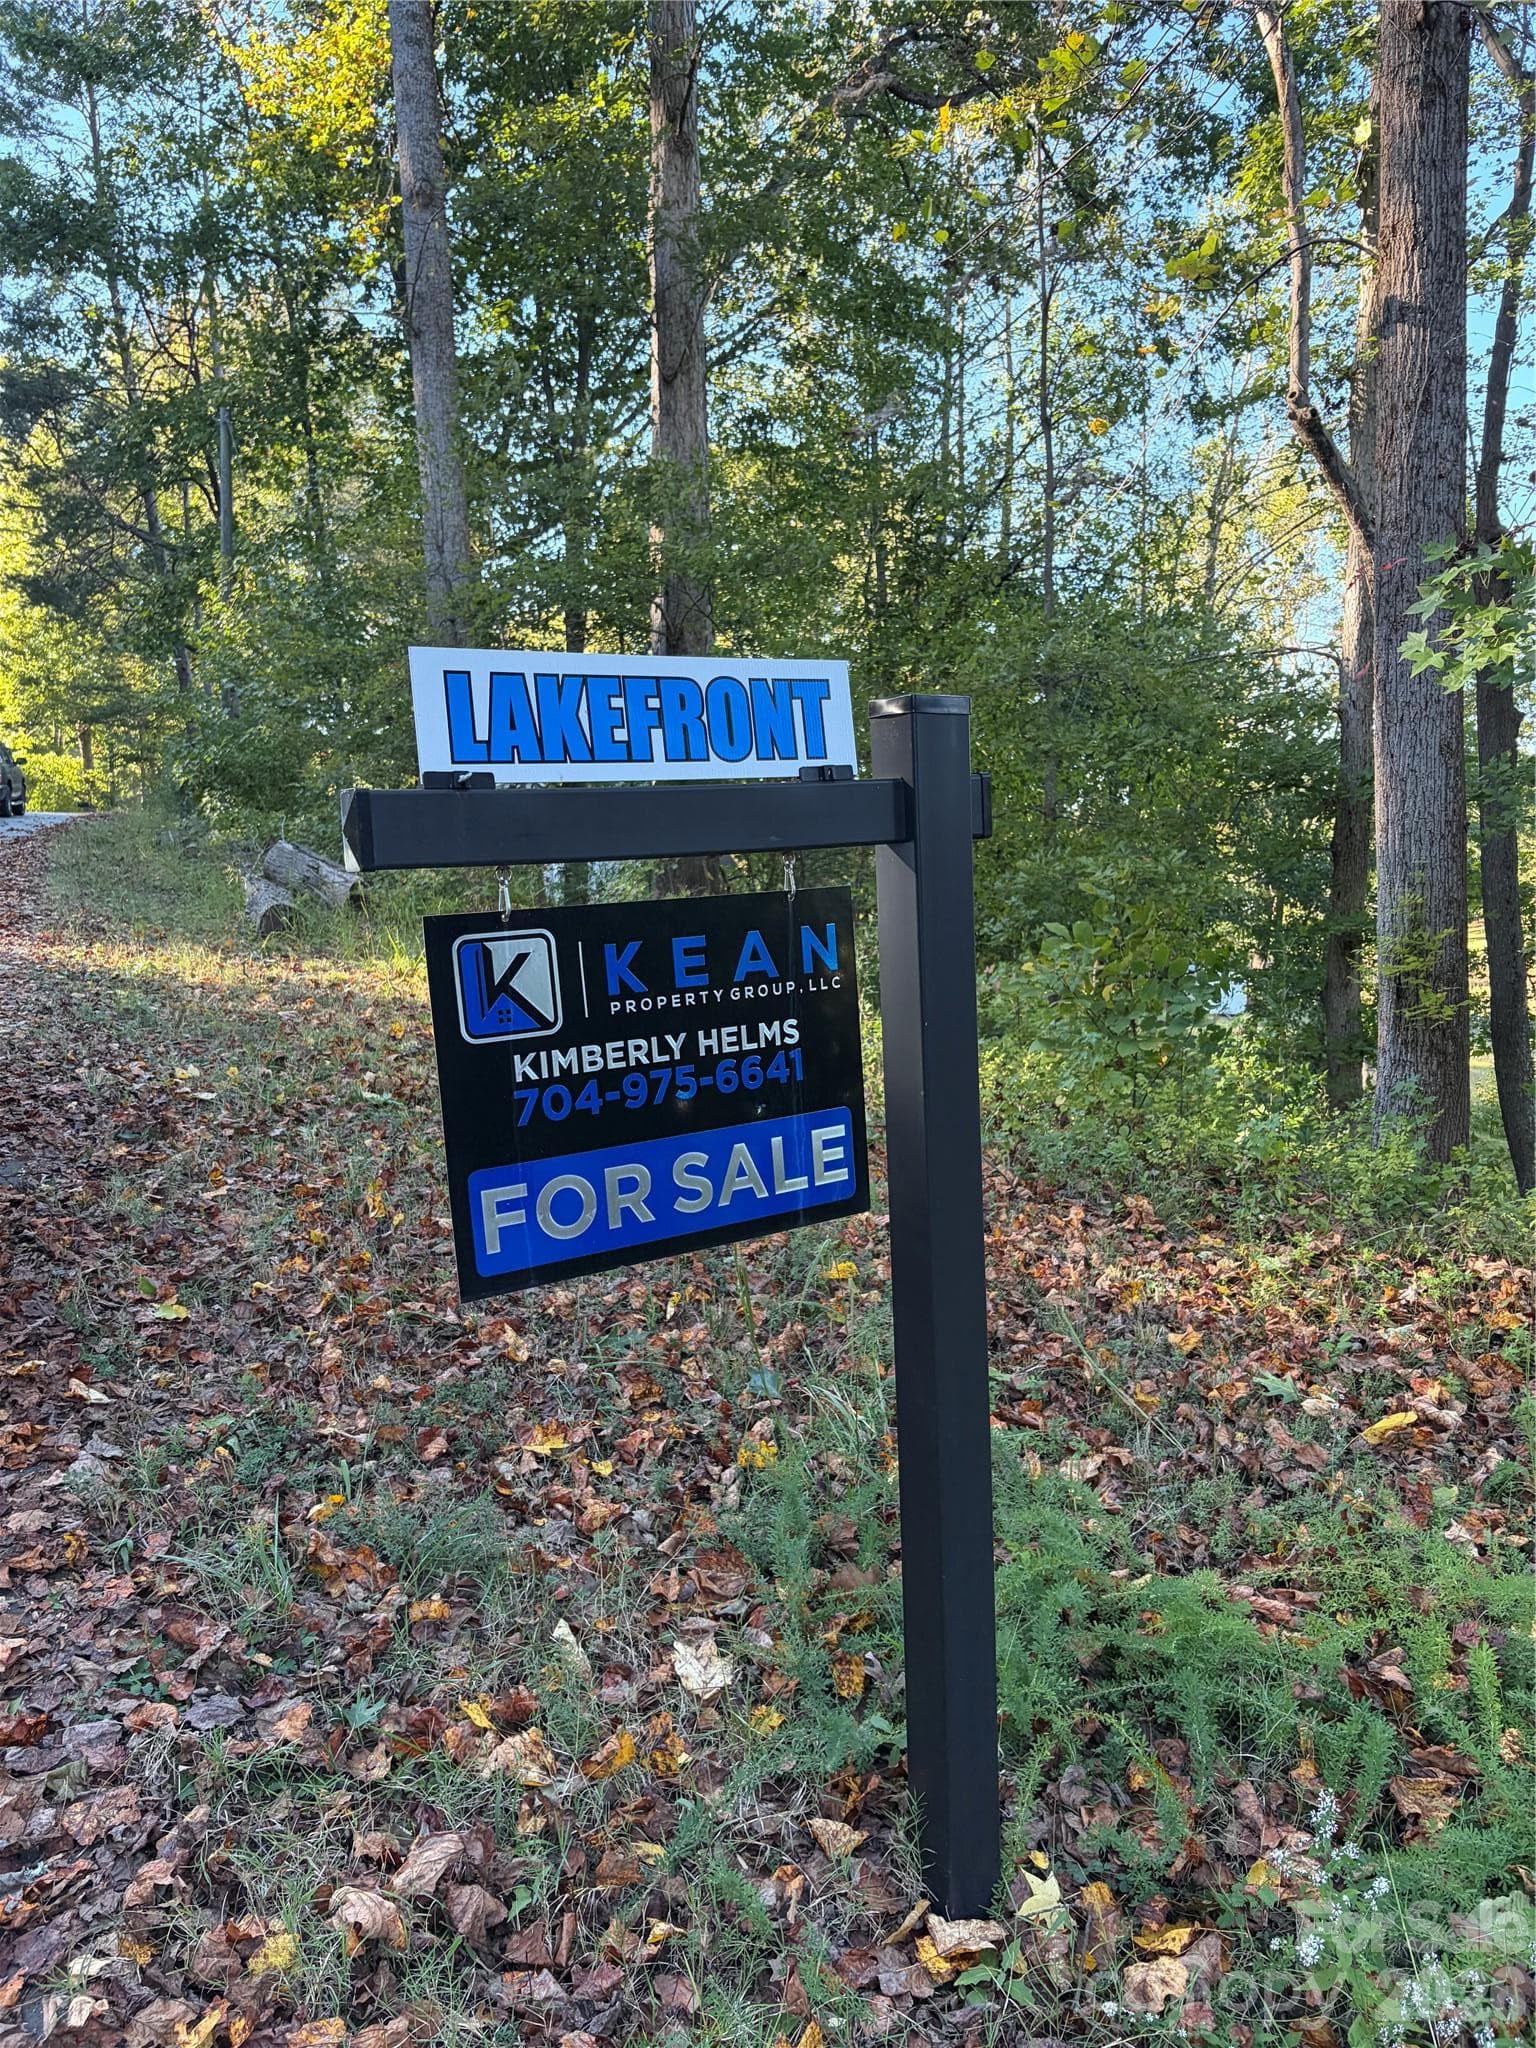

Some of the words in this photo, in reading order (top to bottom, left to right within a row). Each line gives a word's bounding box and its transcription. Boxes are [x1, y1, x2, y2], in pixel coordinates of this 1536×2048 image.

[443, 670, 830, 764] LAKEFRONT
[604, 923, 839, 996] KEAN
[610, 989, 724, 1015] PROPERTY
[809, 976, 841, 991] LLC
[513, 1032, 687, 1082] KIMBERLY
[698, 1018, 800, 1056] HELMS
[513, 1047, 804, 1127] 704-975-6641
[480, 1163, 656, 1254] FOR
[672, 1124, 849, 1213] SALE
